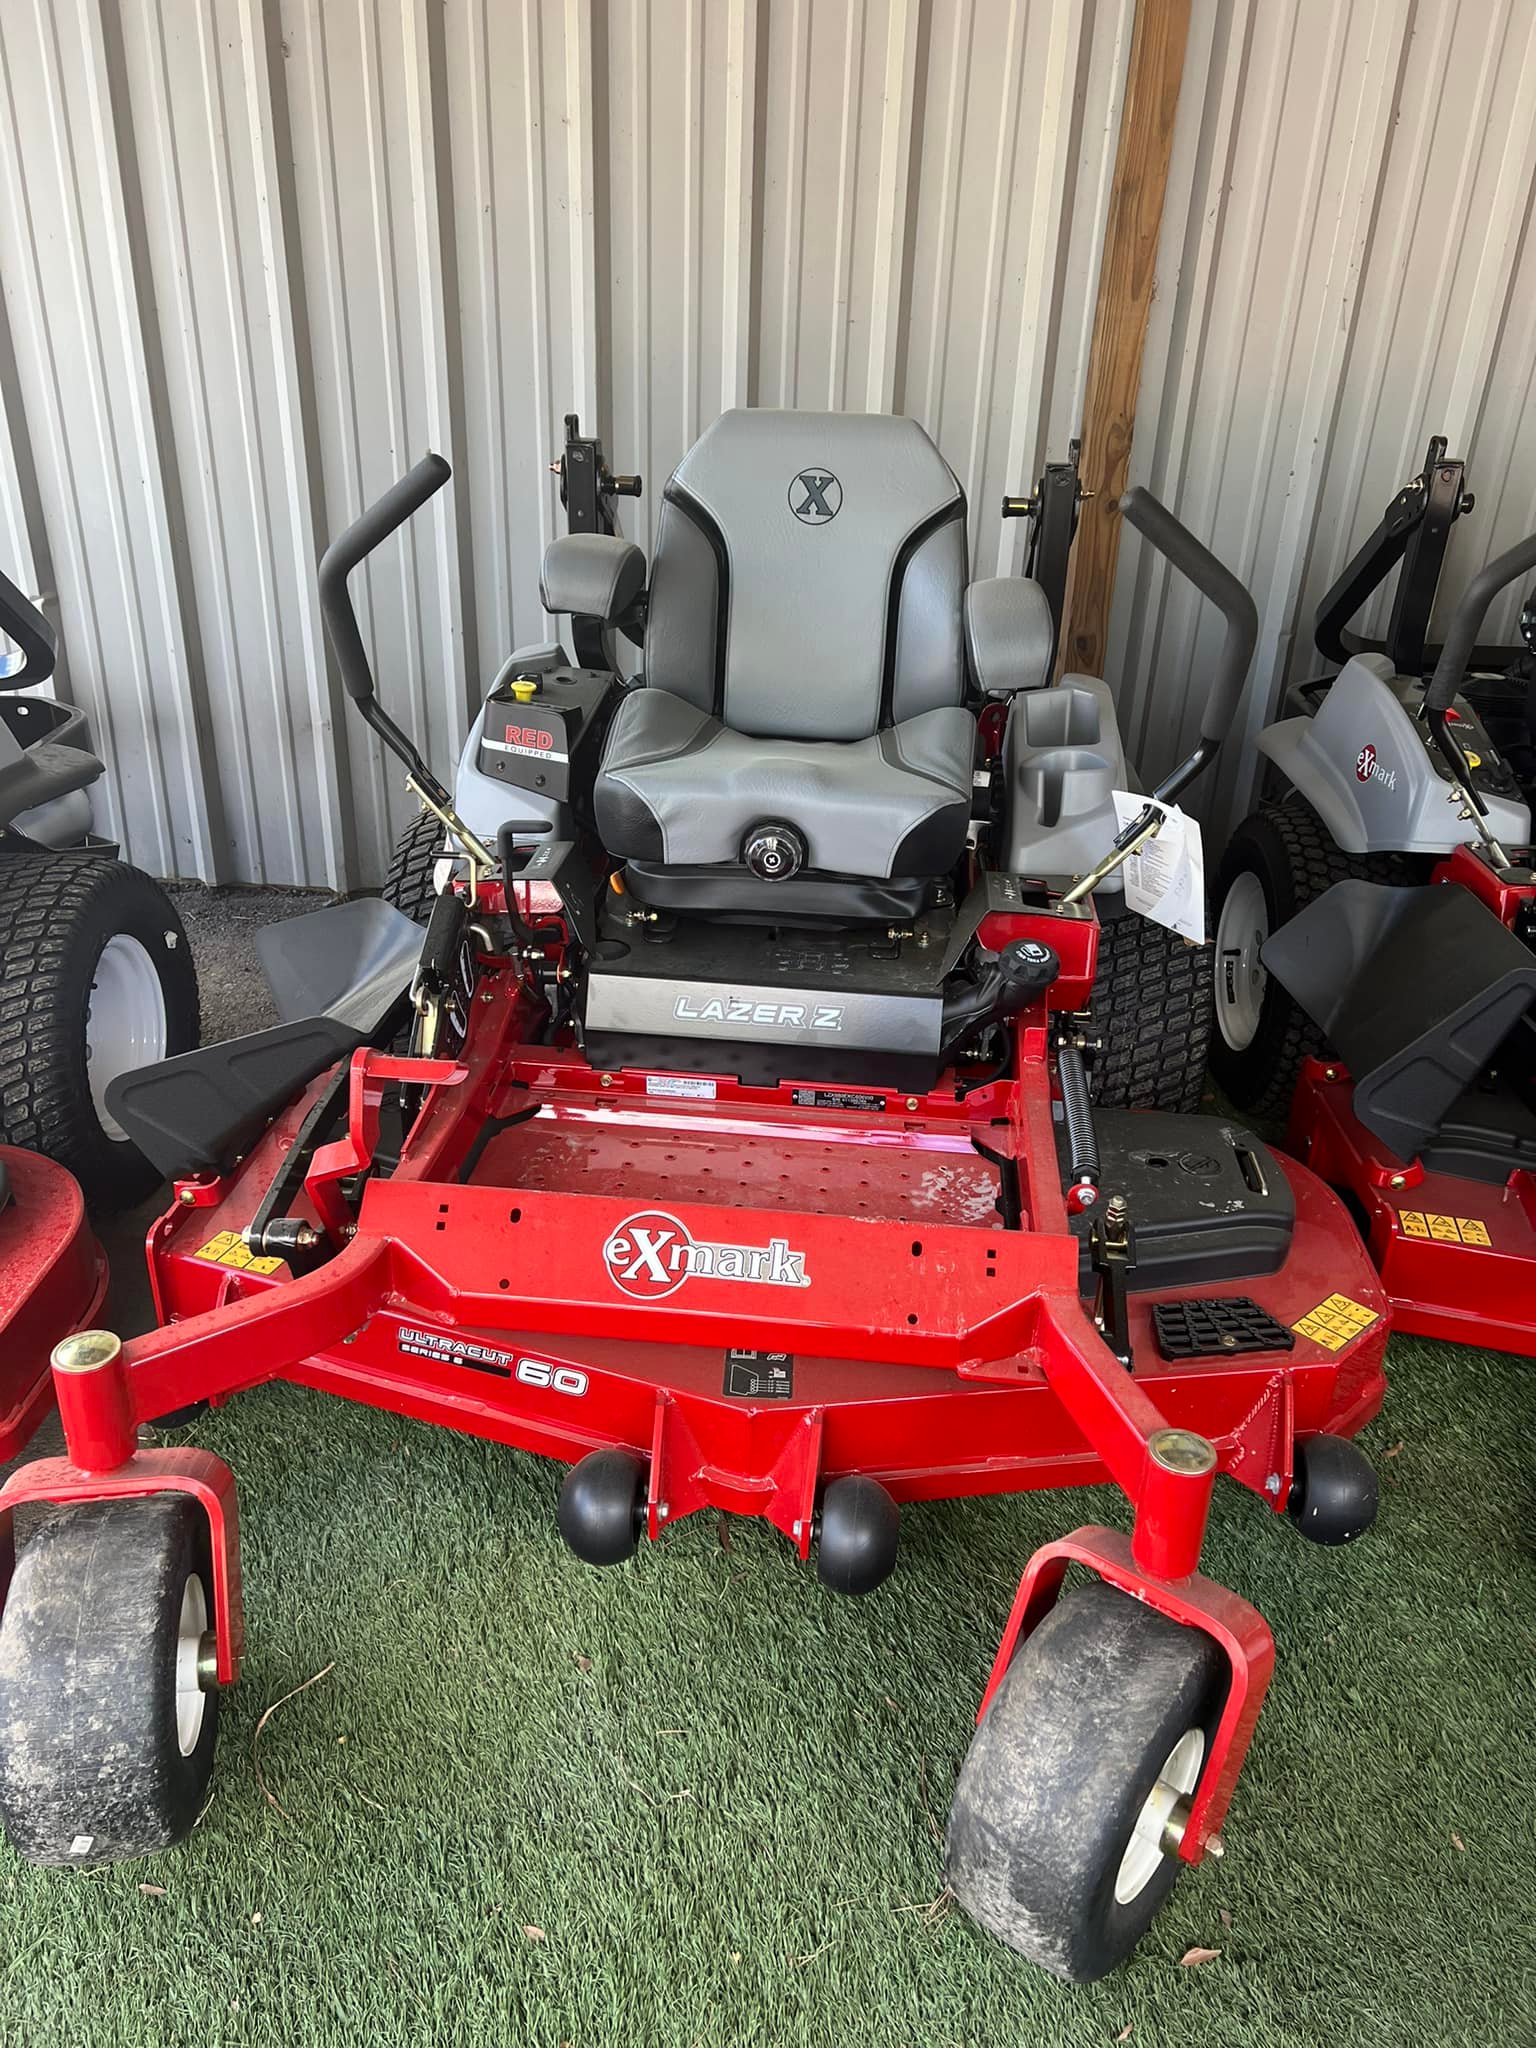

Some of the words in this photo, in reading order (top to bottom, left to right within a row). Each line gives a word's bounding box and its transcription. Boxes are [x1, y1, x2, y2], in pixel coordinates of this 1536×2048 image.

[796, 475, 835, 516] X
[504, 744, 552, 759] EQUIPPED
[505, 725, 553, 750] RED
[675, 996, 806, 1027] LAZER
[811, 1006, 843, 1029] Z
[400, 1328, 512, 1366] ULTRACUT
[517, 1358, 588, 1396] 60
[401, 1343, 450, 1362] SERIES
